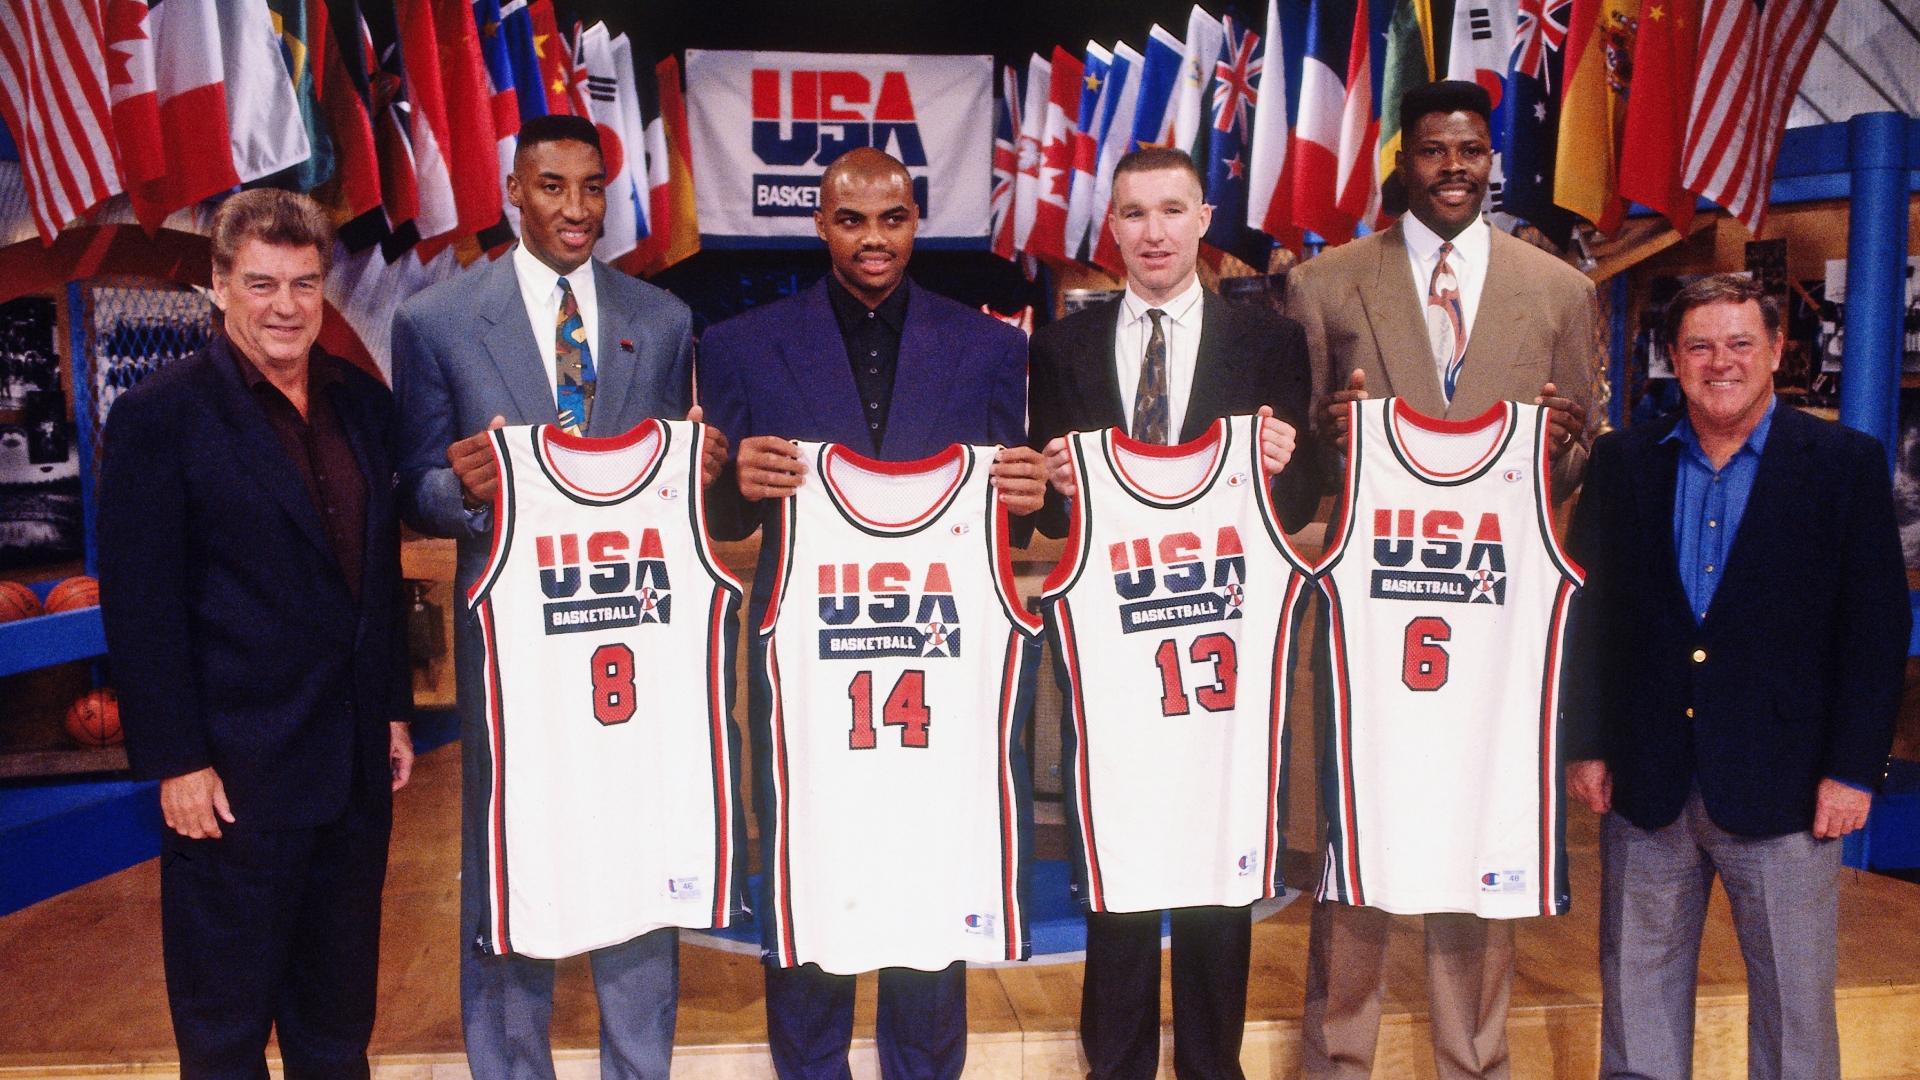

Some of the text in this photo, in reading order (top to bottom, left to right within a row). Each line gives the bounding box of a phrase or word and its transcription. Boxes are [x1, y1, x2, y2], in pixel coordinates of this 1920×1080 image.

[752, 68, 928, 166] USA
[756, 184, 821, 207] BASKET
[536, 528, 671, 599] USA
[1108, 526, 1246, 600] USA
[1373, 509, 1507, 572] USA
[552, 610, 637, 627] BASKETBALL
[818, 562, 960, 625] USA
[1131, 601, 1218, 625] BASKETBALL
[1381, 578, 1465, 596] BASKETBALL
[830, 635, 917, 652] BASKETBALL
[1155, 632, 1238, 717] 13
[1401, 616, 1452, 692] 6
[590, 643, 637, 726] 8
[848, 669, 931, 750] 14
